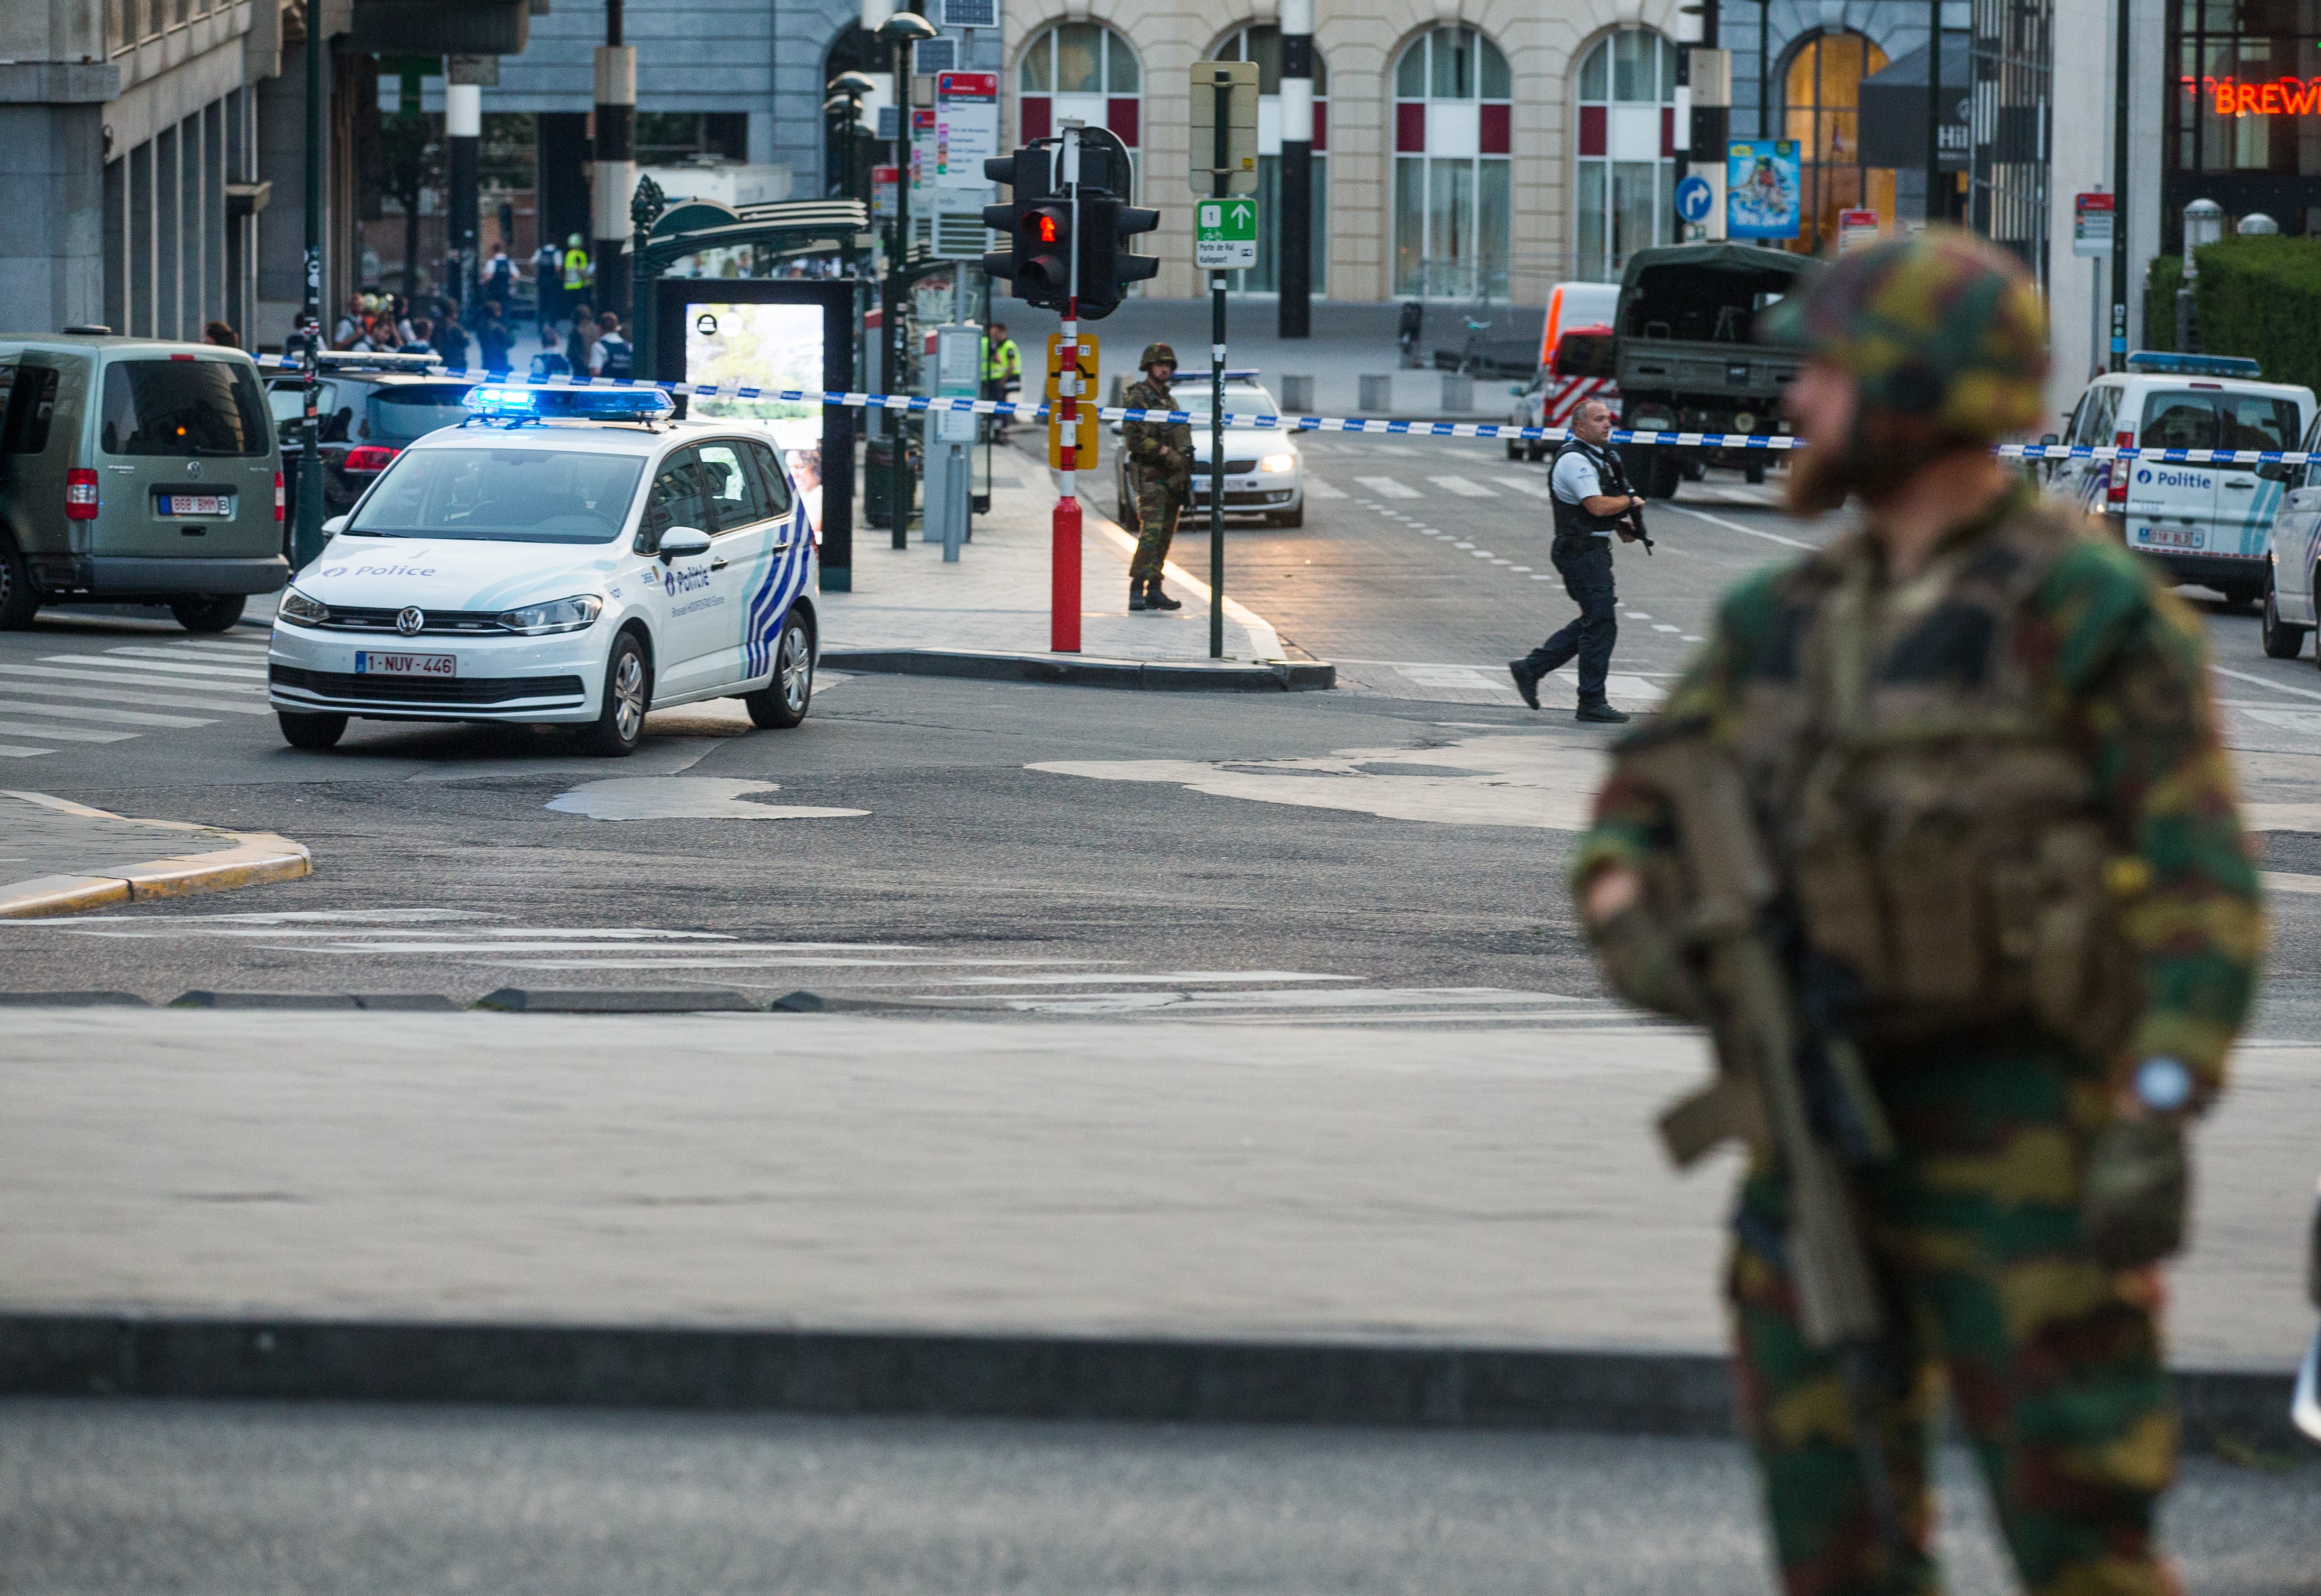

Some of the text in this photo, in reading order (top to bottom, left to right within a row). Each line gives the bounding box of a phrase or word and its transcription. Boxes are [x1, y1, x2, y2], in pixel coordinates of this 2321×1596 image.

[2215, 82, 2321, 115] BREW
[2158, 471, 2211, 489] Politie
[354, 565, 436, 576] Police
[677, 564, 710, 593] Politie
